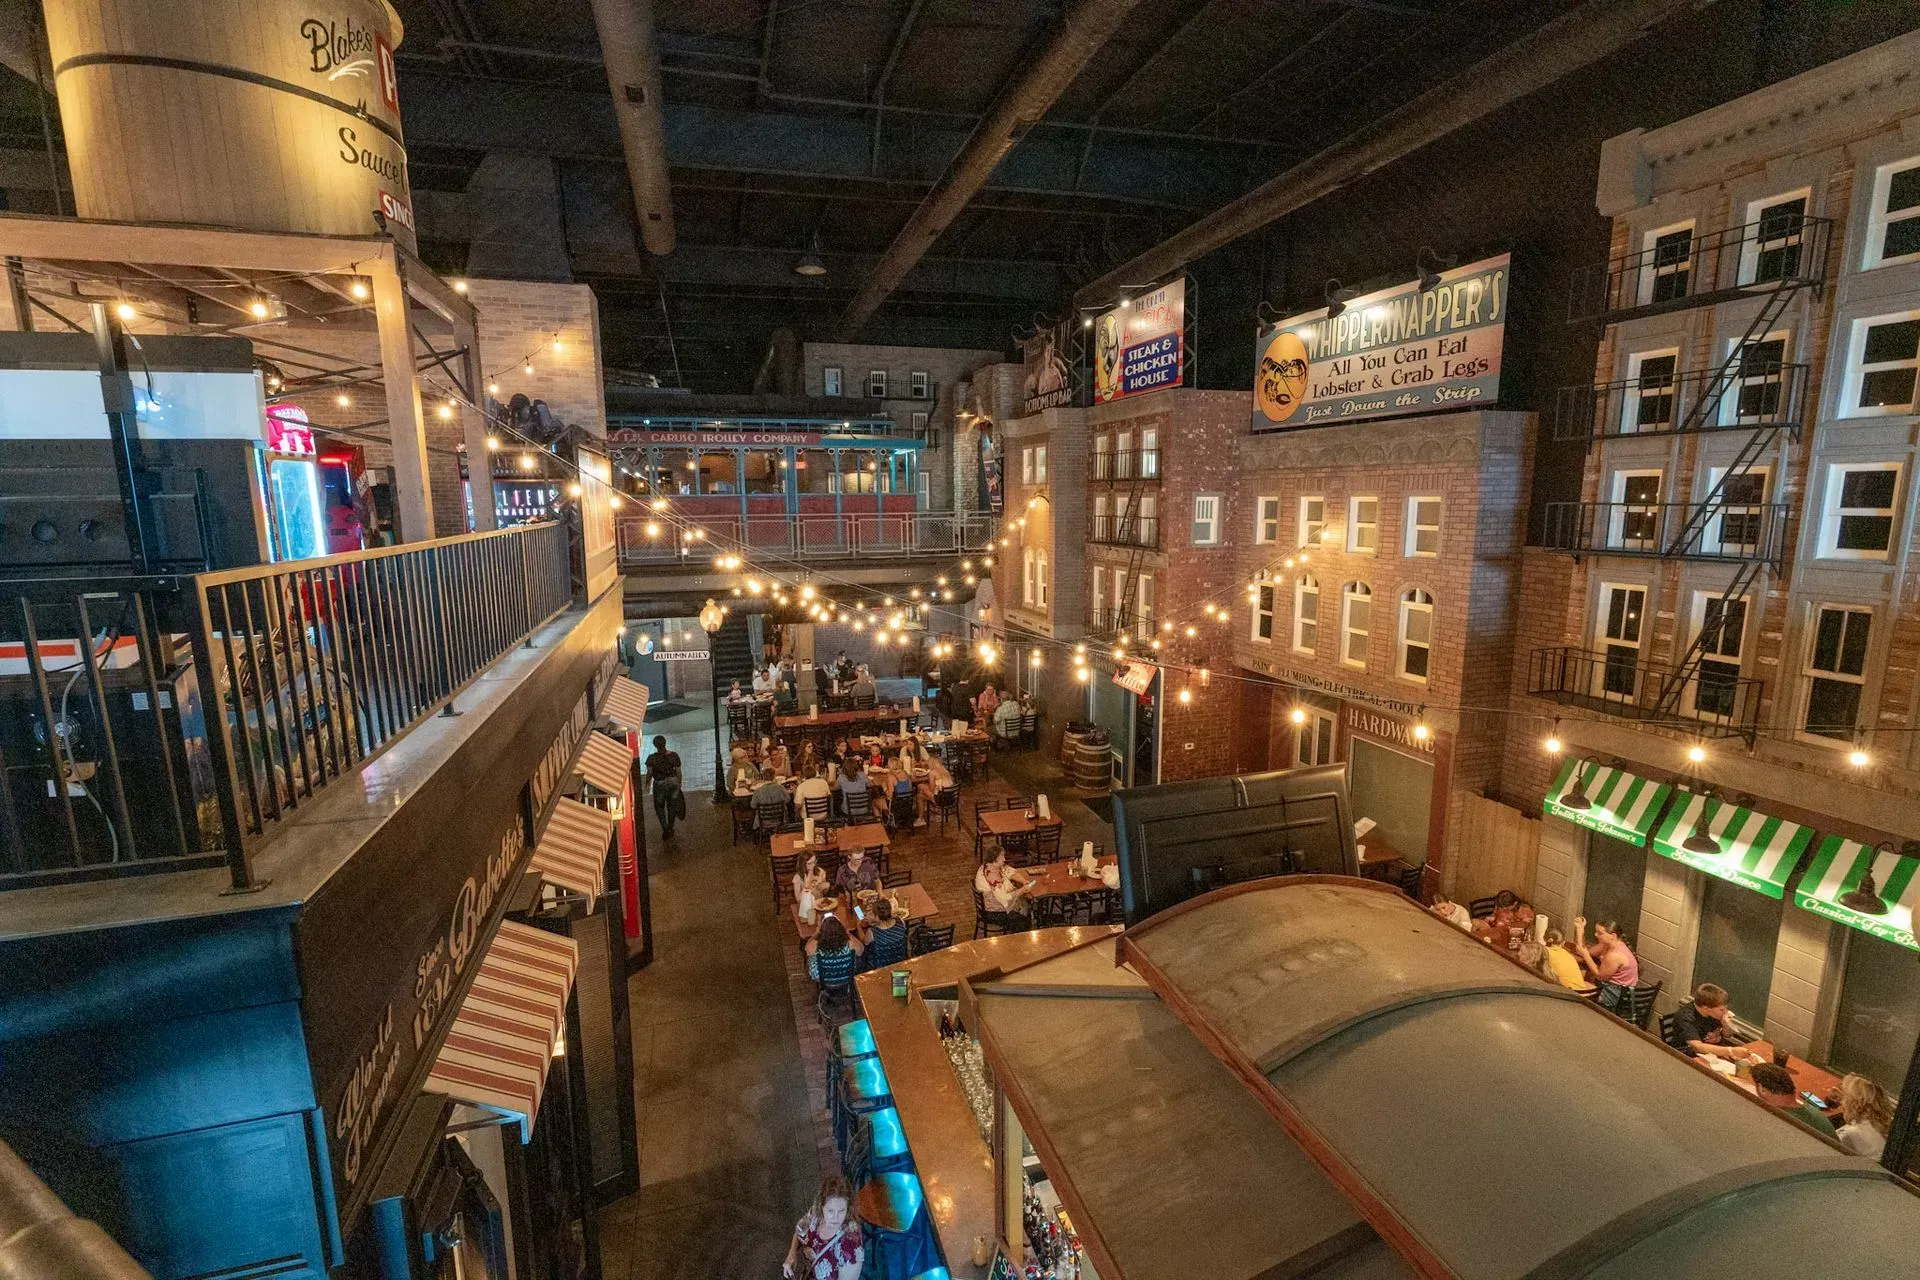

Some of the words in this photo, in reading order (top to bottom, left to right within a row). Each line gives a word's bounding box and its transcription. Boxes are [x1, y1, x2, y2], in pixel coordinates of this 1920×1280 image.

[300, 17, 373, 73] Blake's
[338, 127, 400, 185] Sauce
[1124, 352, 1177, 377] CHICKEN
[1128, 342, 1160, 362] STEAK
[1162, 338, 1172, 350] &
[1327, 358, 1351, 378] All
[1359, 354, 1386, 372] You
[1393, 346, 1428, 366] Can
[1436, 335, 1468, 358] Eat
[1130, 370, 1169, 389] HOUSE
[1312, 378, 1366, 400] Lobster
[1371, 375, 1383, 390] &
[1391, 363, 1434, 386] Crab
[1441, 356, 1489, 380] Legs
[1304, 405, 1333, 424] Just
[1341, 399, 1387, 416] Down
[1395, 392, 1421, 407] the
[1432, 384, 1481, 405] Strip
[651, 433, 697, 443] CARUSO
[702, 433, 747, 443] TROLLEY
[753, 434, 808, 443] COMPANY
[502, 489, 556, 507] LIENS
[1387, 700, 1424, 718] TOOLS
[449, 813, 524, 976] Babette's
[1802, 898, 1858, 925] Classical
[336, 1002, 393, 1140] World
[345, 1041, 401, 1185] Famous
